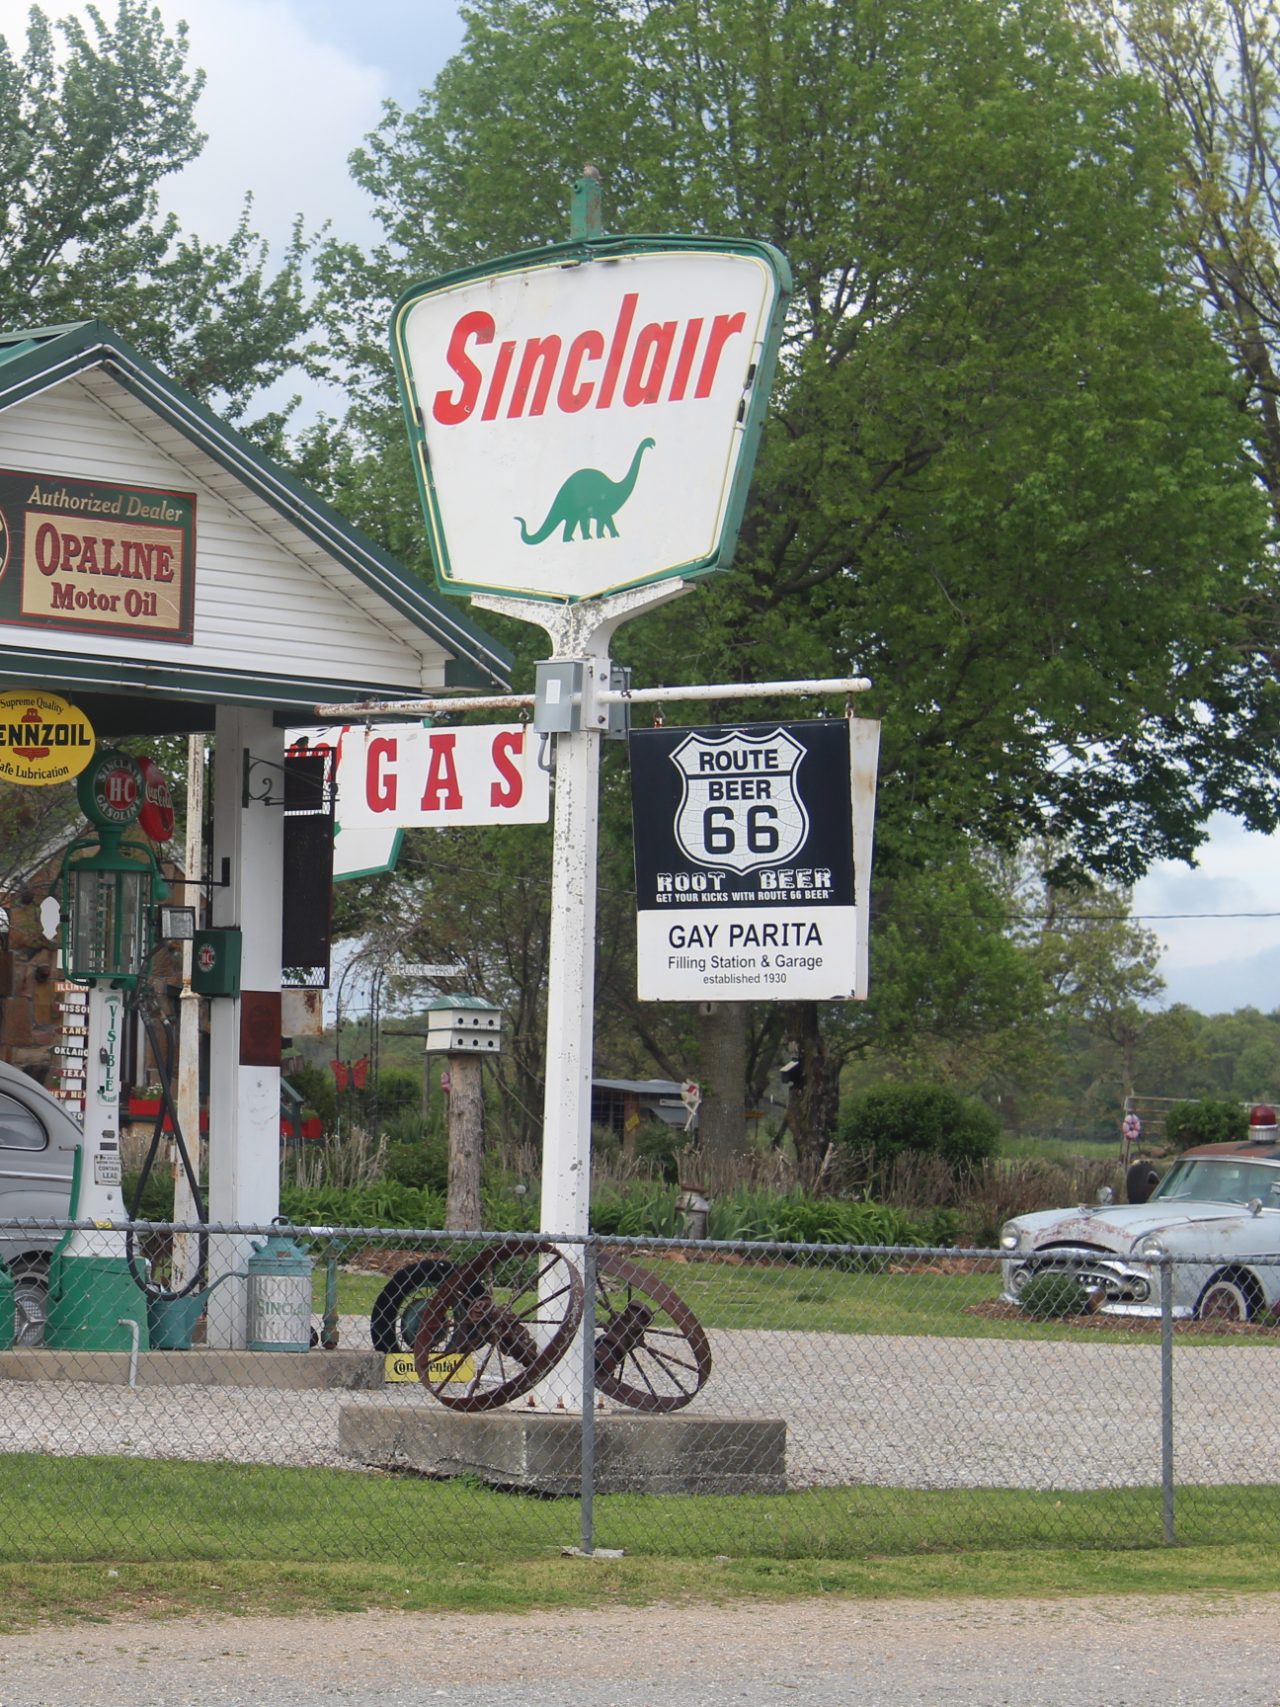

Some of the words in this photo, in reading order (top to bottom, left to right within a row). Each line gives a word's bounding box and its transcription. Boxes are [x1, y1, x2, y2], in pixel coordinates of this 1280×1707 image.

[432, 293, 747, 426] Sinclair
[27, 484, 121, 515] Authorized
[126, 496, 183, 523] Dealer
[35, 522, 175, 584] OPALINE
[50, 582, 121, 612] Motor
[124, 588, 157, 617] Oil
[0, 698, 35, 710] Supreme
[36, 697, 64, 715] Quality
[16, 766, 69, 779] Lubrication
[365, 731, 524, 813] GAS
[699, 749, 779, 772] ROUTE
[708, 780, 771, 801] BEER
[703, 805, 779, 855] 66
[657, 871, 725, 892] ROOT
[759, 868, 831, 889] BEER
[656, 893, 672, 902] GET
[675, 893, 699, 902] YOUR
[701, 892, 728, 902] KICKS
[732, 891, 755, 901] WITH
[758, 890, 787, 900] ROUTE
[790, 890, 802, 900] 66
[669, 924, 719, 948] GAY
[730, 923, 823, 947] PARITA
[668, 956, 706, 972] Filling
[711, 955, 756, 968] Station
[761, 955, 770, 967] &
[775, 954, 823, 970] Garage
[703, 973, 760, 984] established
[763, 973, 786, 984] 1930
[106, 1005, 118, 1091] VISIBLE
[394, 1360, 459, 1375] Conental
